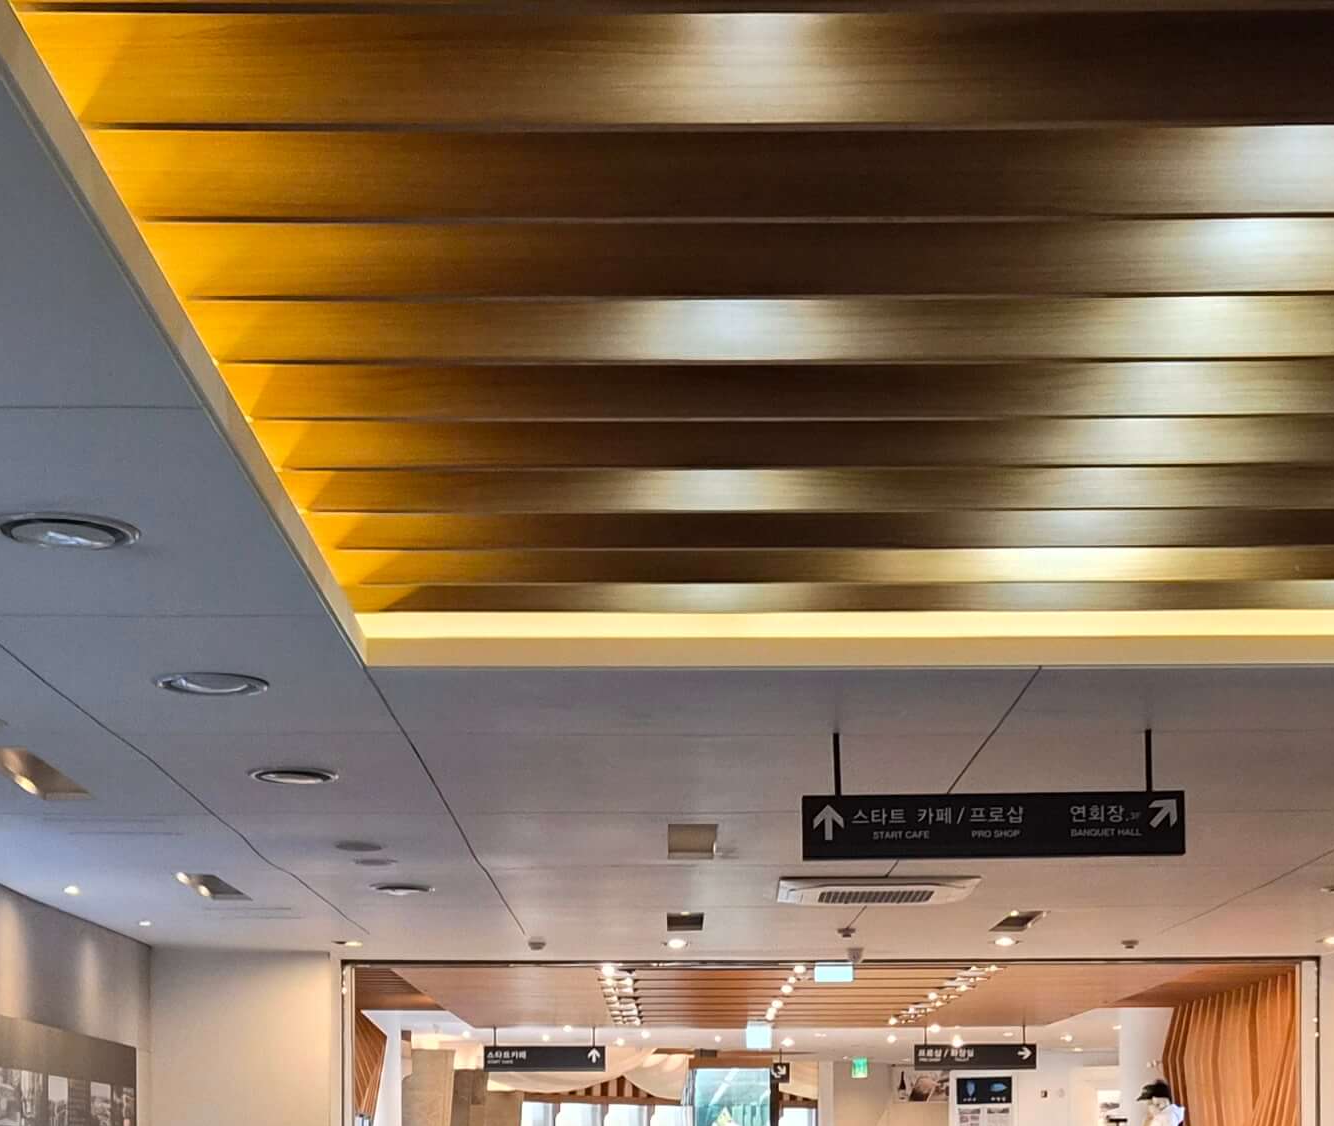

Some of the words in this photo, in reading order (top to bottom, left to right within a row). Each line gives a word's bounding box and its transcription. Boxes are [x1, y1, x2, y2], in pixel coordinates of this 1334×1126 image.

[851, 808, 906, 825] 스타트
[873, 831, 902, 840] START
[905, 830, 930, 839] CAFE
[971, 830, 992, 838] PRO
[994, 830, 1020, 838] SHOP
[1071, 828, 1115, 837] BANQUET
[1118, 828, 1143, 837] HALL
